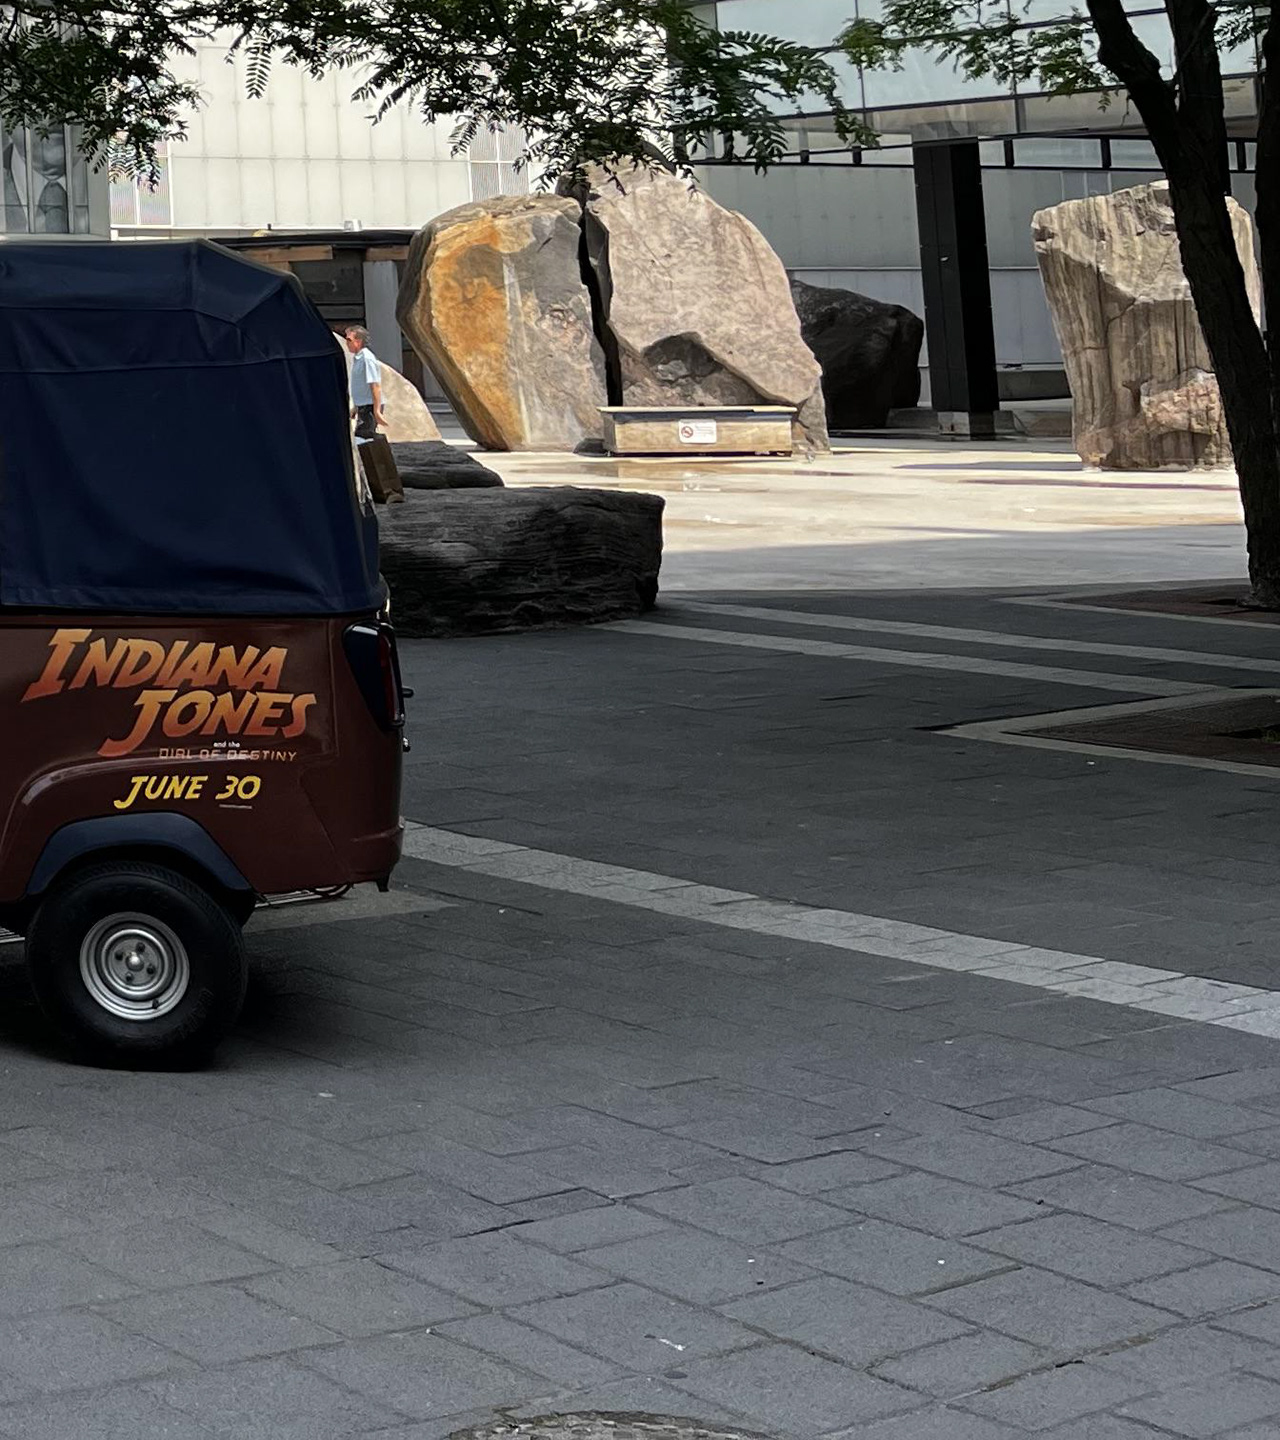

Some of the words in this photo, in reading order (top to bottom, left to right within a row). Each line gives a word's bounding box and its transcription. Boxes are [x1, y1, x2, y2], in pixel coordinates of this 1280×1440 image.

[21, 628, 288, 702] INDIANA
[97, 689, 317, 757] JONES
[159, 748, 192, 759] DIAL
[199, 749, 221, 760] OF
[226, 750, 298, 762] DESTINY
[113, 775, 208, 809] JUNE
[215, 775, 261, 800] 30
